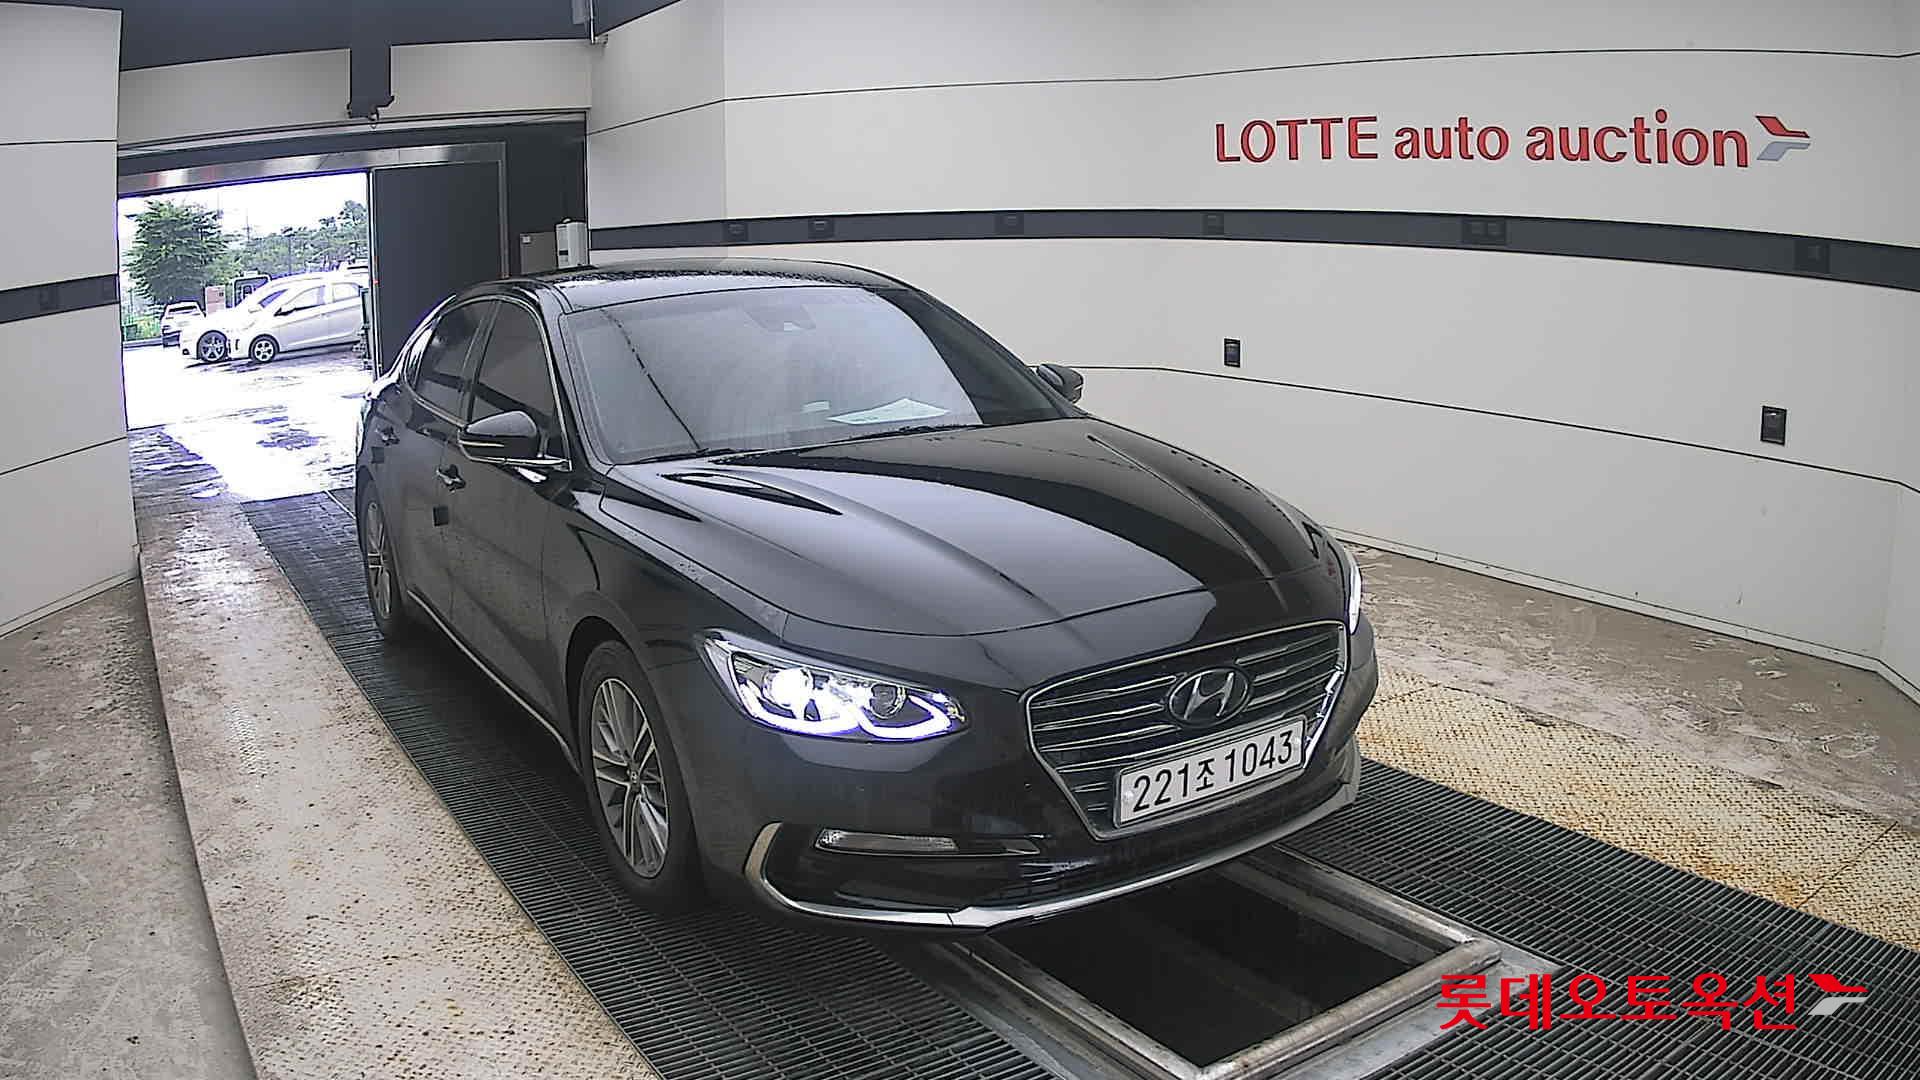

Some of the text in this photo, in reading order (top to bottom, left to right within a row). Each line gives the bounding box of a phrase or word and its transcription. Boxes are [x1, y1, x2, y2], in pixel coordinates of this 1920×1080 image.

[1216, 108, 1749, 168] LOTTE auto auction
[1225, 730, 1293, 782] 1043
